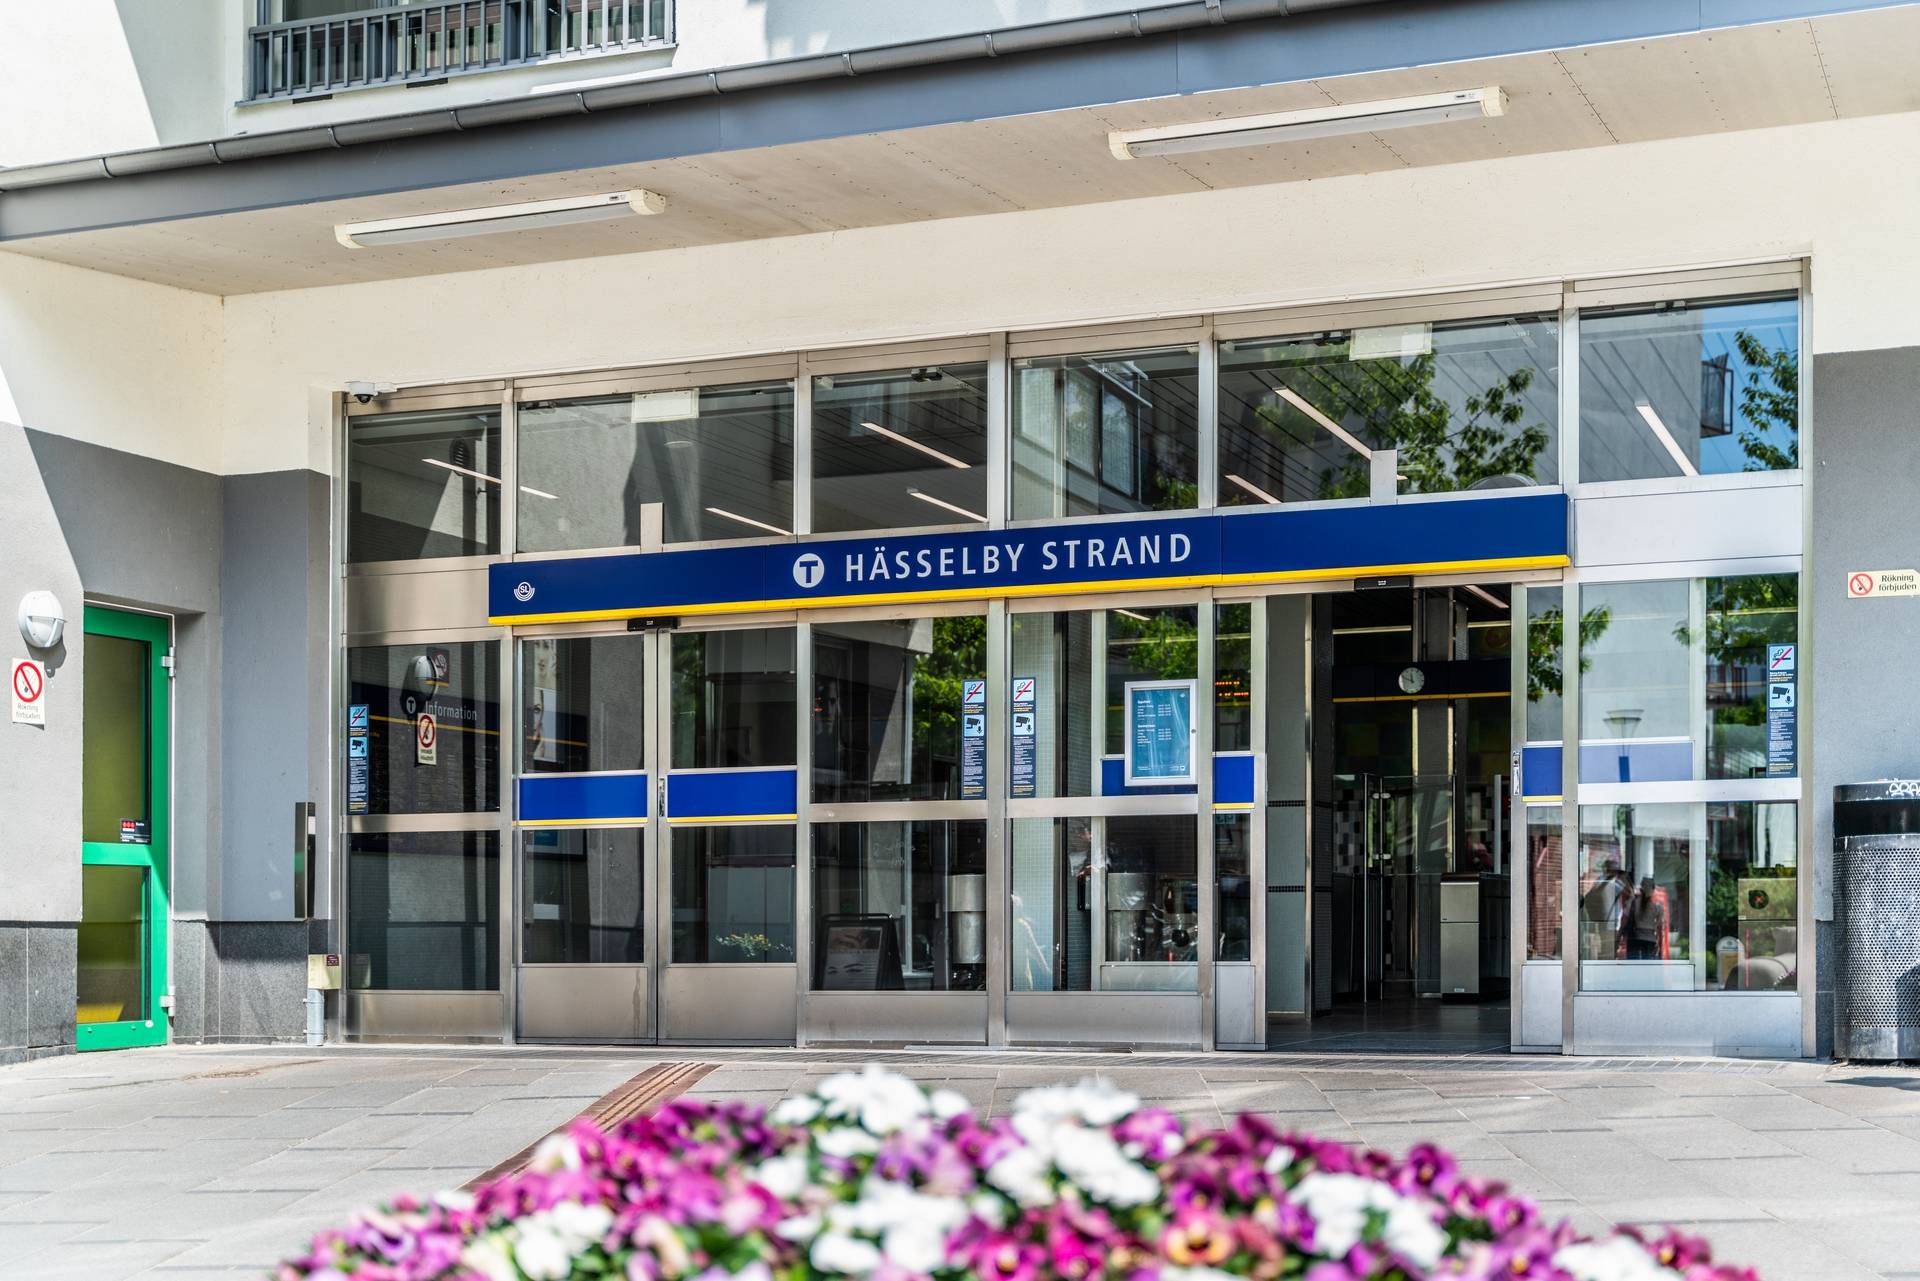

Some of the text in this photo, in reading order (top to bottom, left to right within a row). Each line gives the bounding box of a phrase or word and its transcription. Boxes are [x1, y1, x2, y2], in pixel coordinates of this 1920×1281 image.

[797, 533, 1191, 585] T HÄSSELBY STRAND
[1881, 574, 1914, 582] Rökning
[1878, 583, 1917, 592] förbjuden
[425, 701, 478, 721] Information
